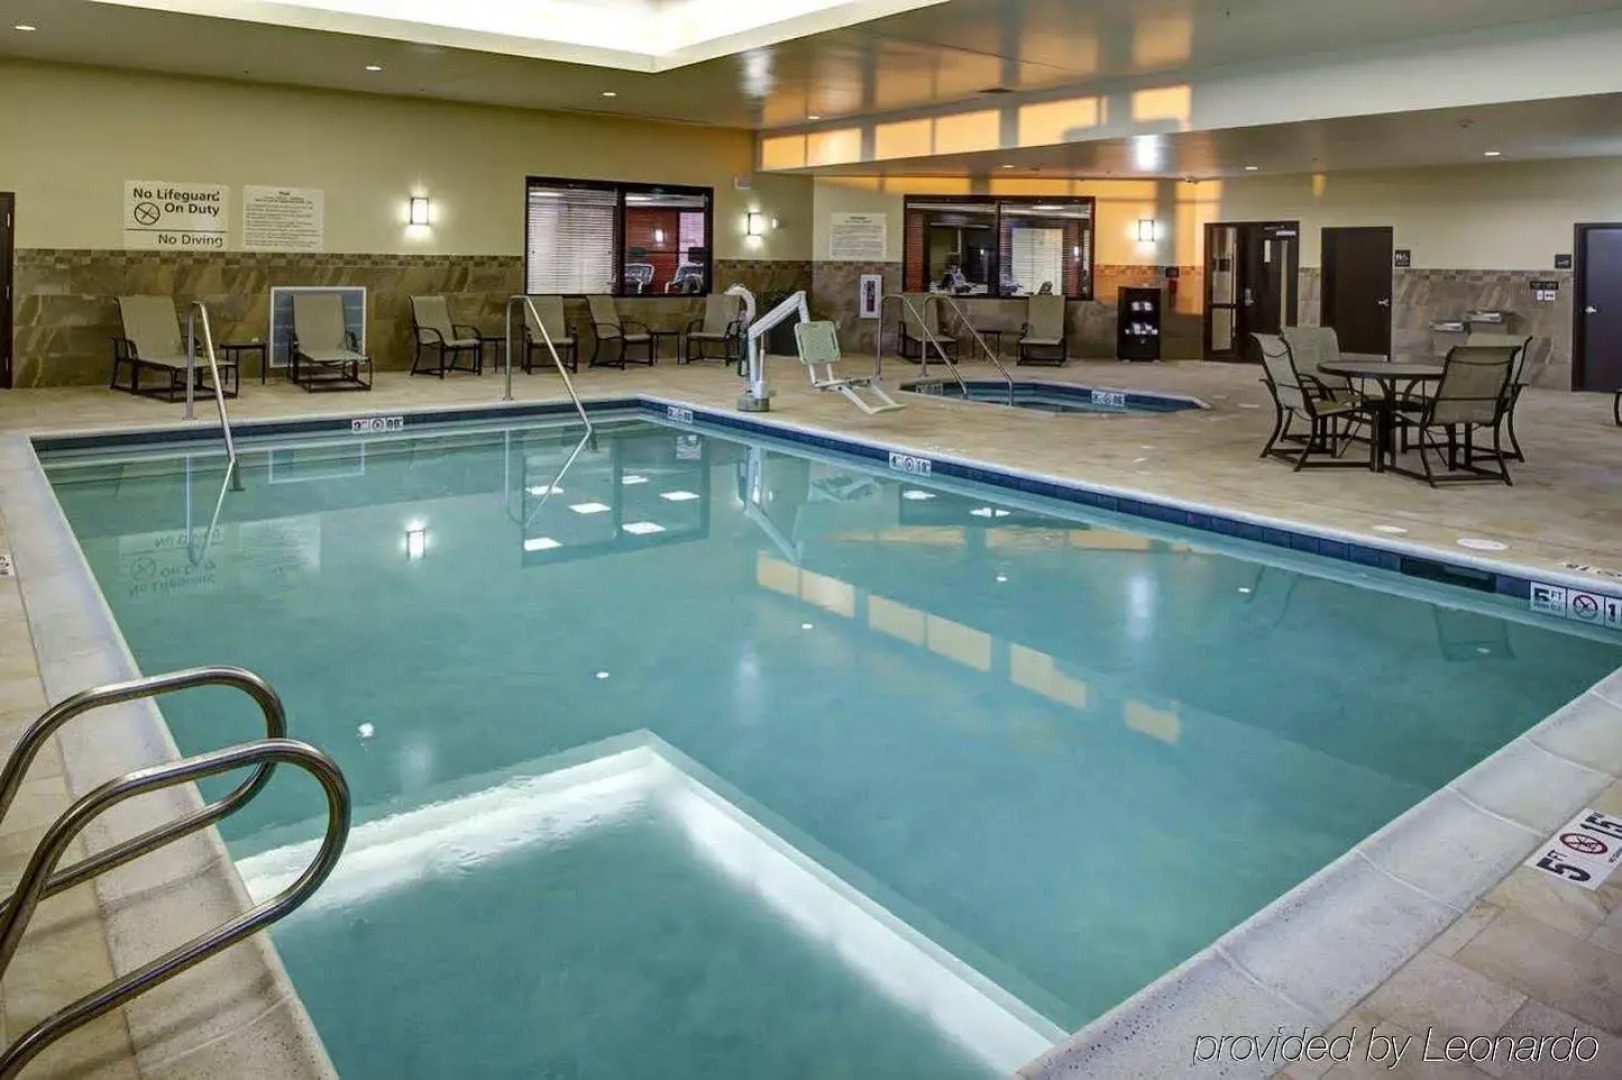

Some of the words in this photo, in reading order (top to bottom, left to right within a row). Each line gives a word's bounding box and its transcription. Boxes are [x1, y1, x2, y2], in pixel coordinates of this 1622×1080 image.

[133, 188, 153, 199] No
[157, 189, 220, 203] Lifeguard
[164, 202, 184, 213] On
[188, 203, 220, 217] Duty
[158, 234, 177, 245] No
[181, 234, 223, 248] Diving
